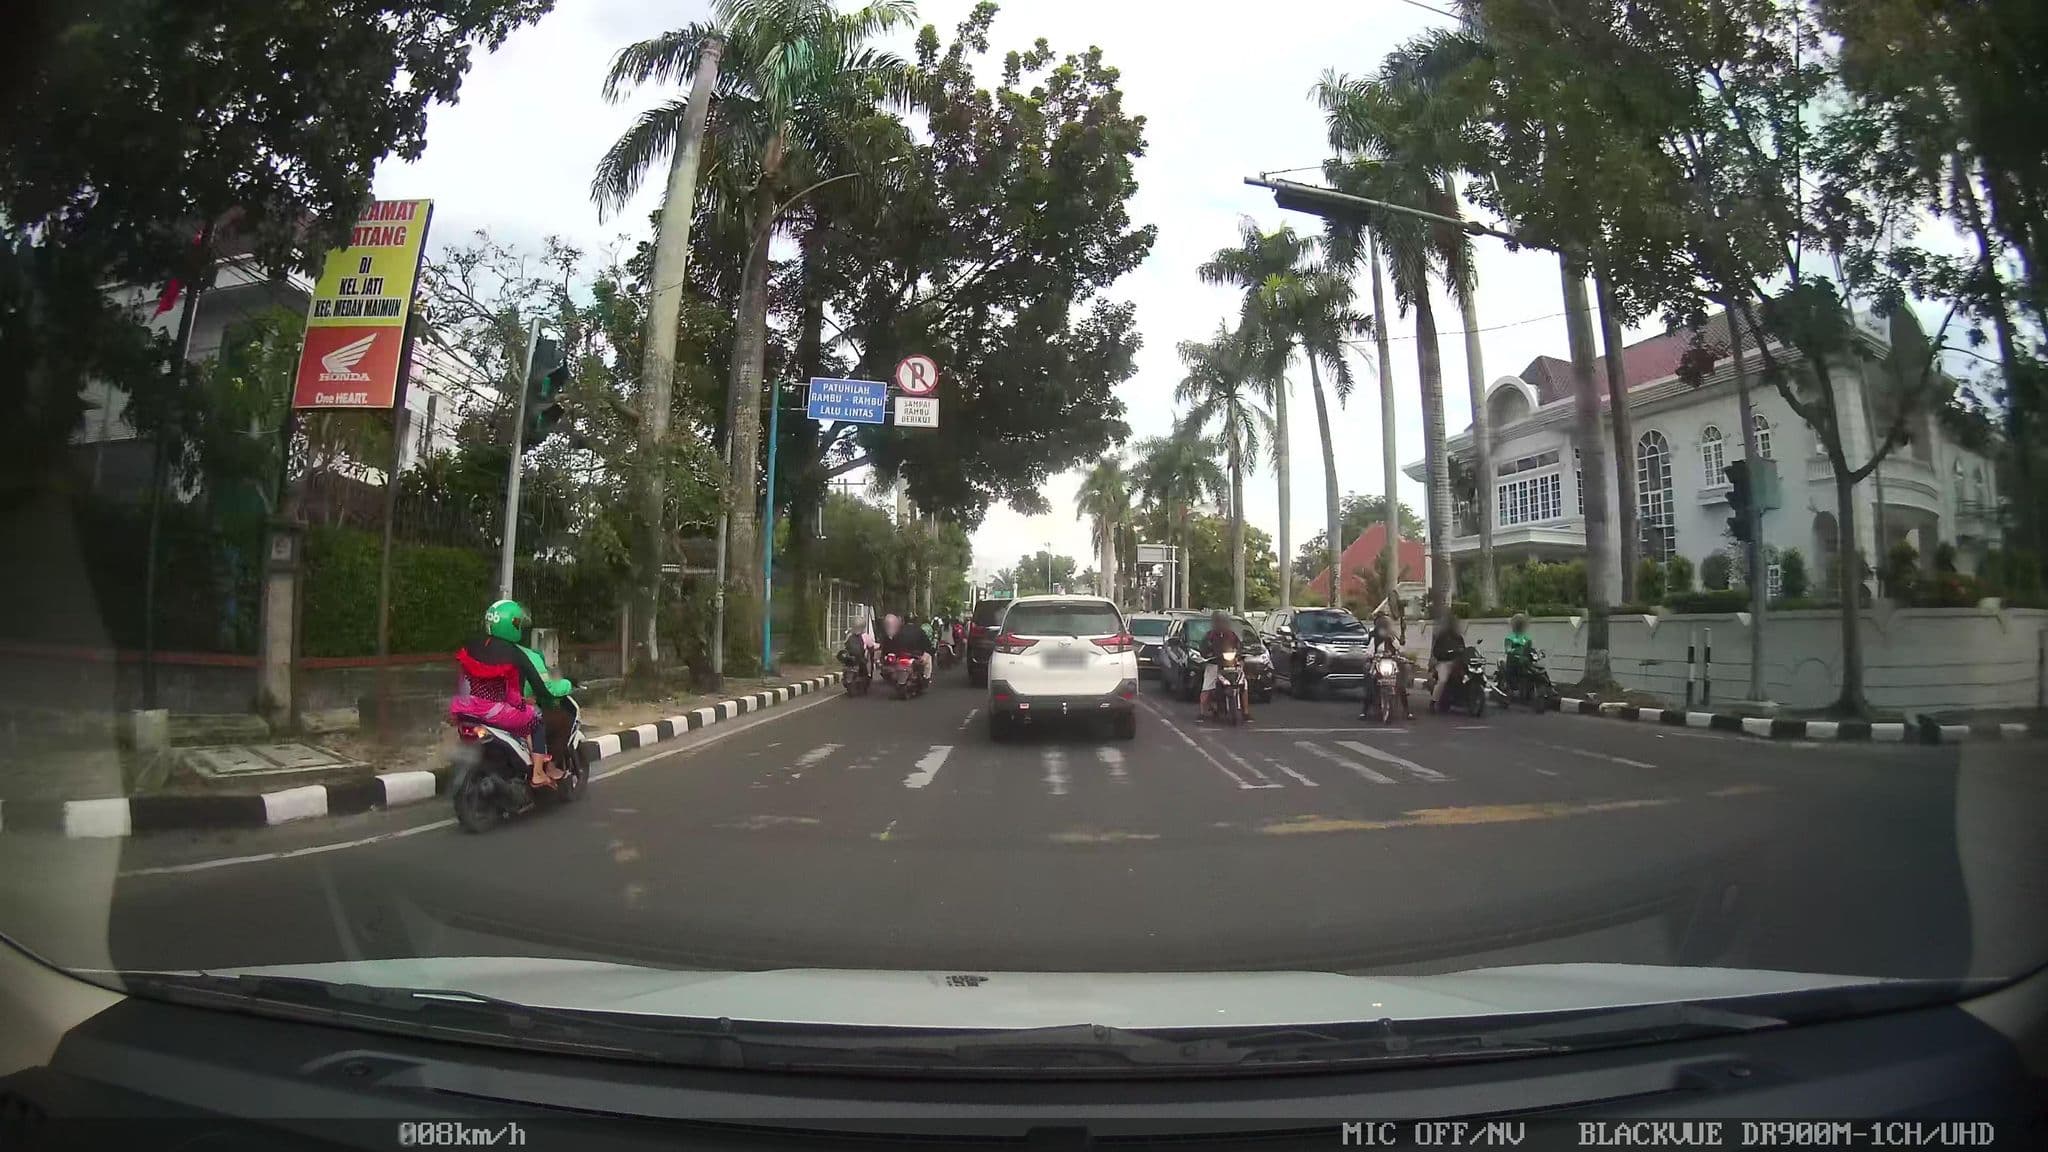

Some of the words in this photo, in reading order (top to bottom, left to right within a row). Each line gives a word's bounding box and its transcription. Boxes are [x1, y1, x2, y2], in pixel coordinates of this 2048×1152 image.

[350, 226, 407, 246] ATANG
[359, 257, 372, 274] DI
[339, 278, 359, 296] KEL.
[361, 278, 384, 295] JATI
[333, 300, 363, 317] MEDAN
[364, 299, 401, 317] MAIMUN
[319, 373, 371, 381] HONDA
[823, 383, 870, 395] PATUHILAH
[315, 393, 335, 404] One
[811, 392, 842, 403] RAMBU
[852, 397, 882, 407] RAMBU
[820, 405, 841, 416] LALU
[845, 407, 874, 418] LINTAS
